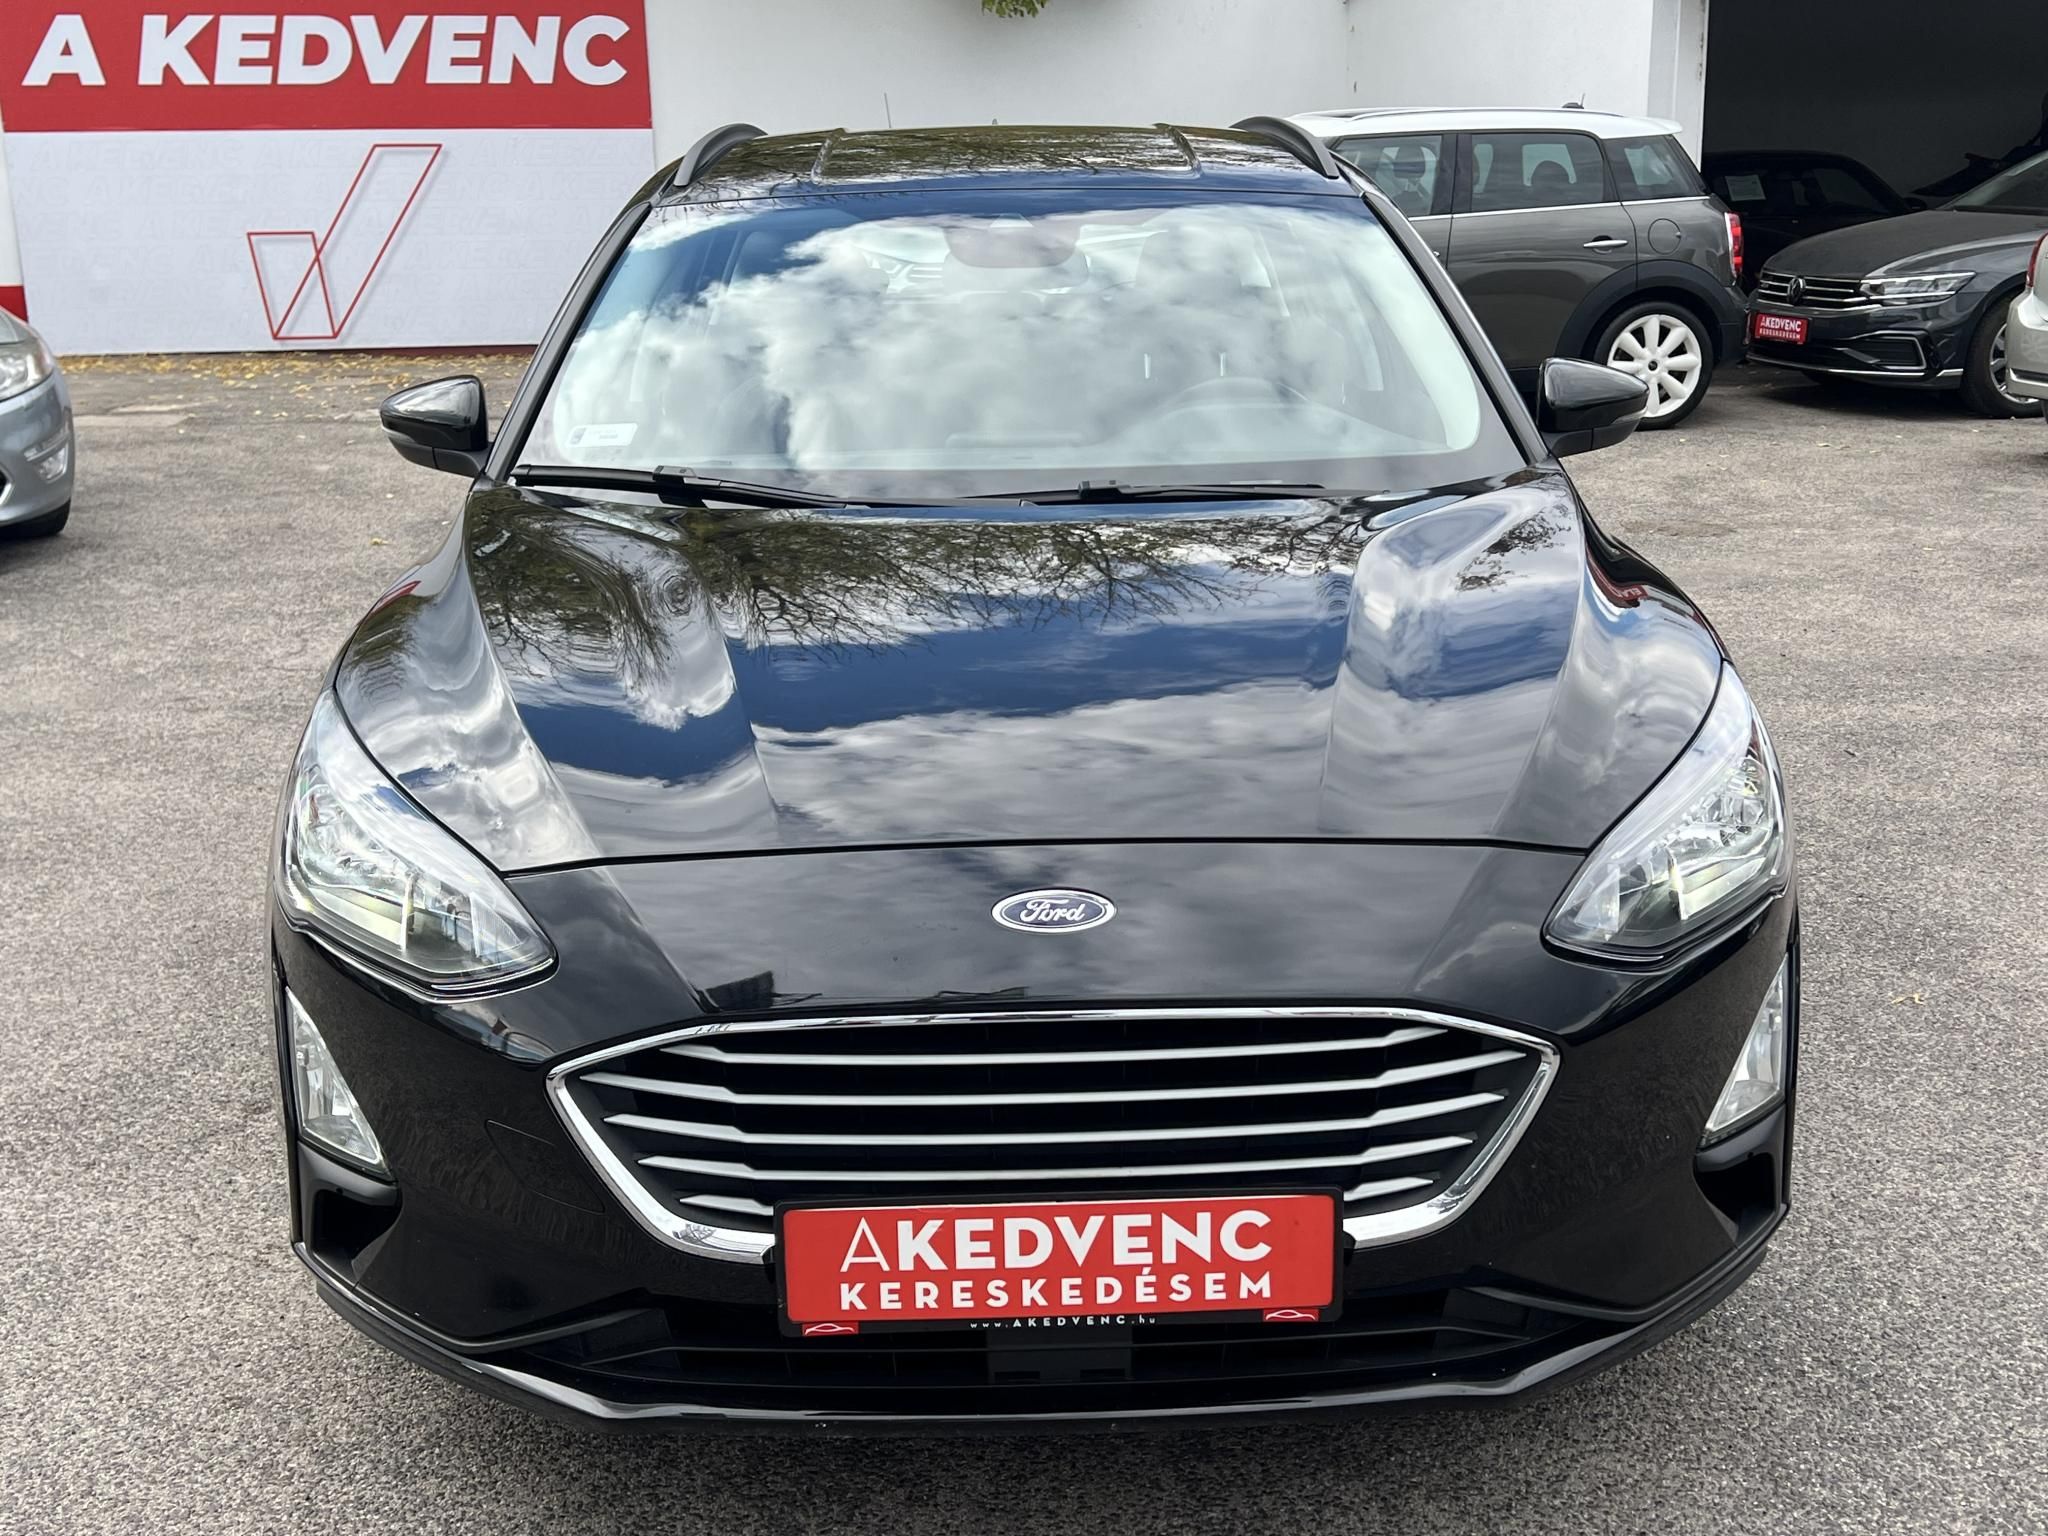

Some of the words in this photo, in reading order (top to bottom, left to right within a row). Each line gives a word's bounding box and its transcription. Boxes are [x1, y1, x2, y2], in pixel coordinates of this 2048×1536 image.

[22, 15, 105, 86] A
[139, 15, 630, 86] KEDVENC
[1019, 898, 1086, 922] Ford
[841, 1267, 1271, 1310] KERESKEDÉSEM
[970, 1315, 1156, 1329] www.AKEDVENC.hu
